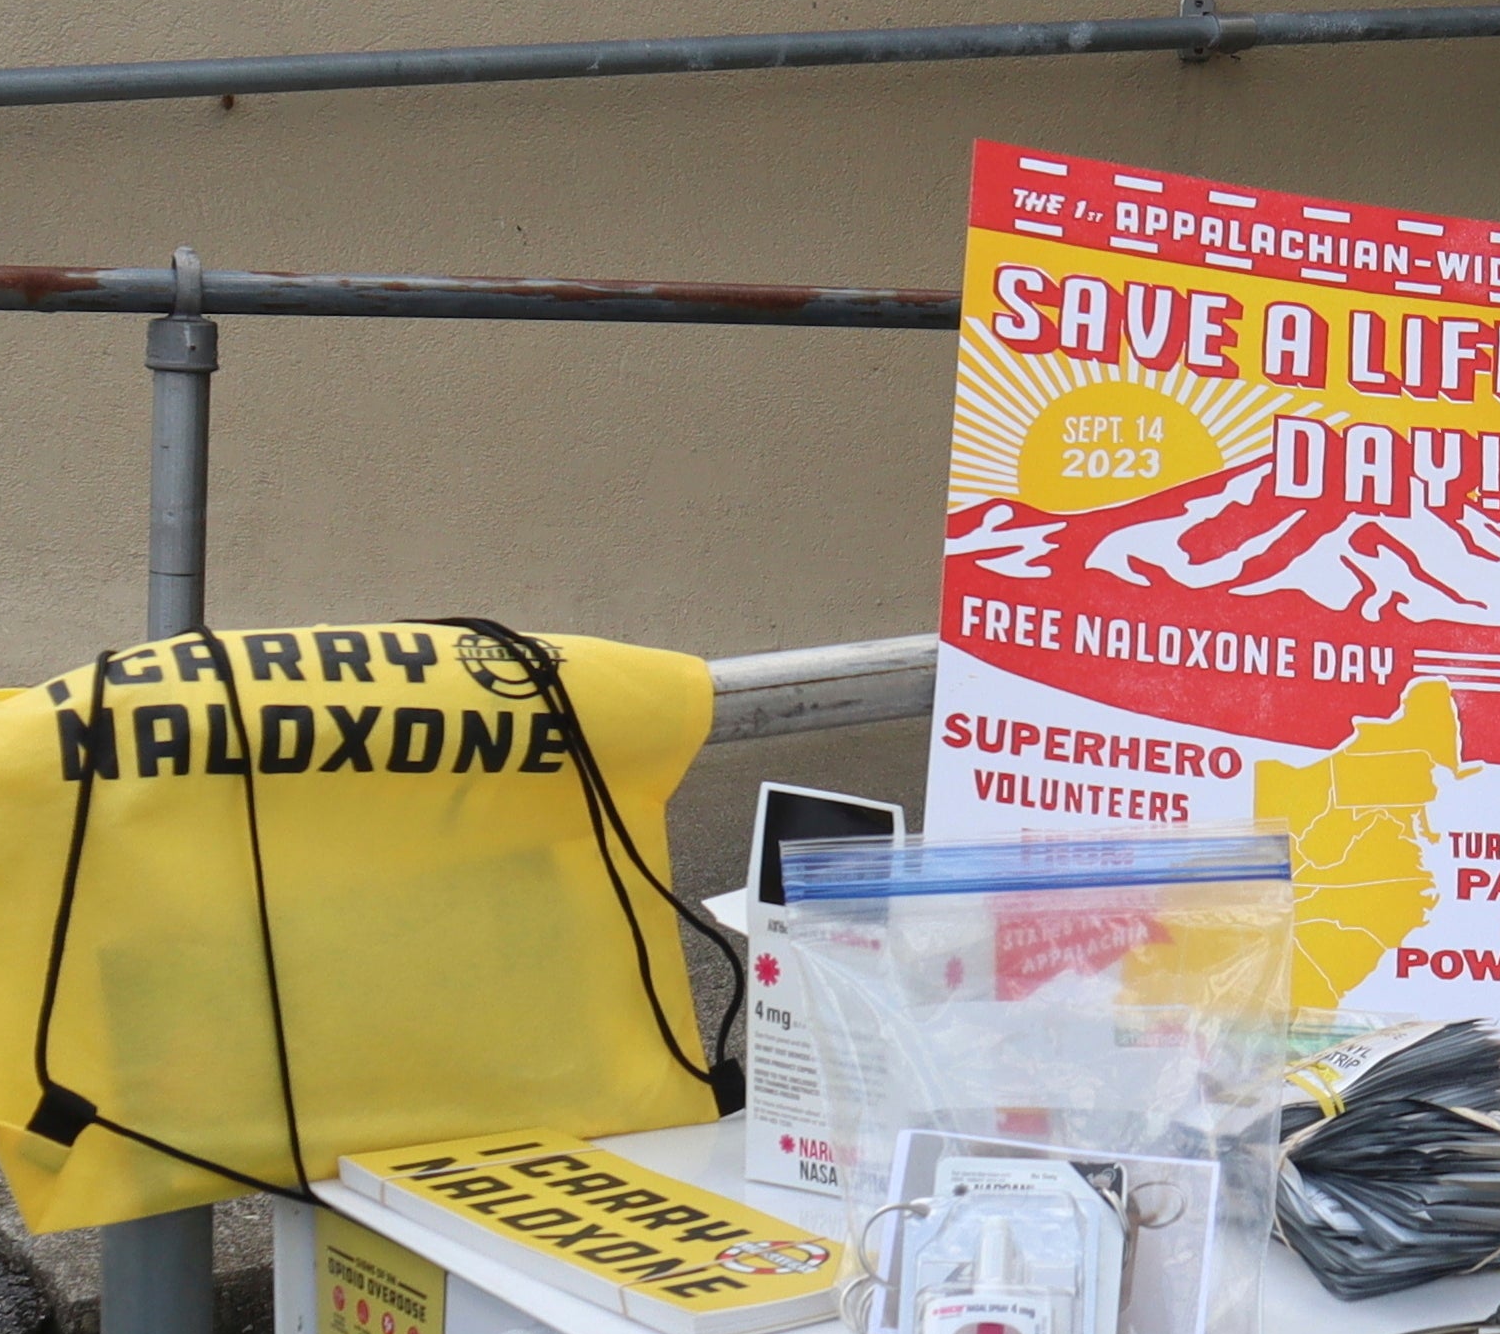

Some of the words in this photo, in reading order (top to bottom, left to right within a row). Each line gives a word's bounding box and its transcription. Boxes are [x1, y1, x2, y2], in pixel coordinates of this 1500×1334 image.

[1013, 188, 1065, 215] THE
[994, 265, 1237, 372] SAVE
[1263, 302, 1318, 383] A
[1062, 415, 1123, 444] SEPT.
[1137, 416, 1164, 443] 14
[1062, 449, 1160, 479] 2023
[106, 631, 439, 685] CARRY
[961, 596, 1060, 651] FREE
[1075, 617, 1295, 679] NALOXONE
[1313, 643, 1394, 685] DAY
[56, 704, 569, 781] NALOXONE
[942, 712, 1243, 780] SUPERHERO
[973, 769, 1190, 824] VOLUNTEERS
[755, 1000, 764, 1019] 4
[767, 1008, 791, 1030] mg
[477, 1142, 543, 1156] I
[800, 1160, 838, 1186] NASA
[508, 1154, 752, 1243] CARRY
[391, 1156, 748, 1298] NALOXONE
[328, 1257, 364, 1290] OPIOID
[367, 1278, 426, 1323] OVERDOSE
[1011, 1303, 1017, 1314] 4
